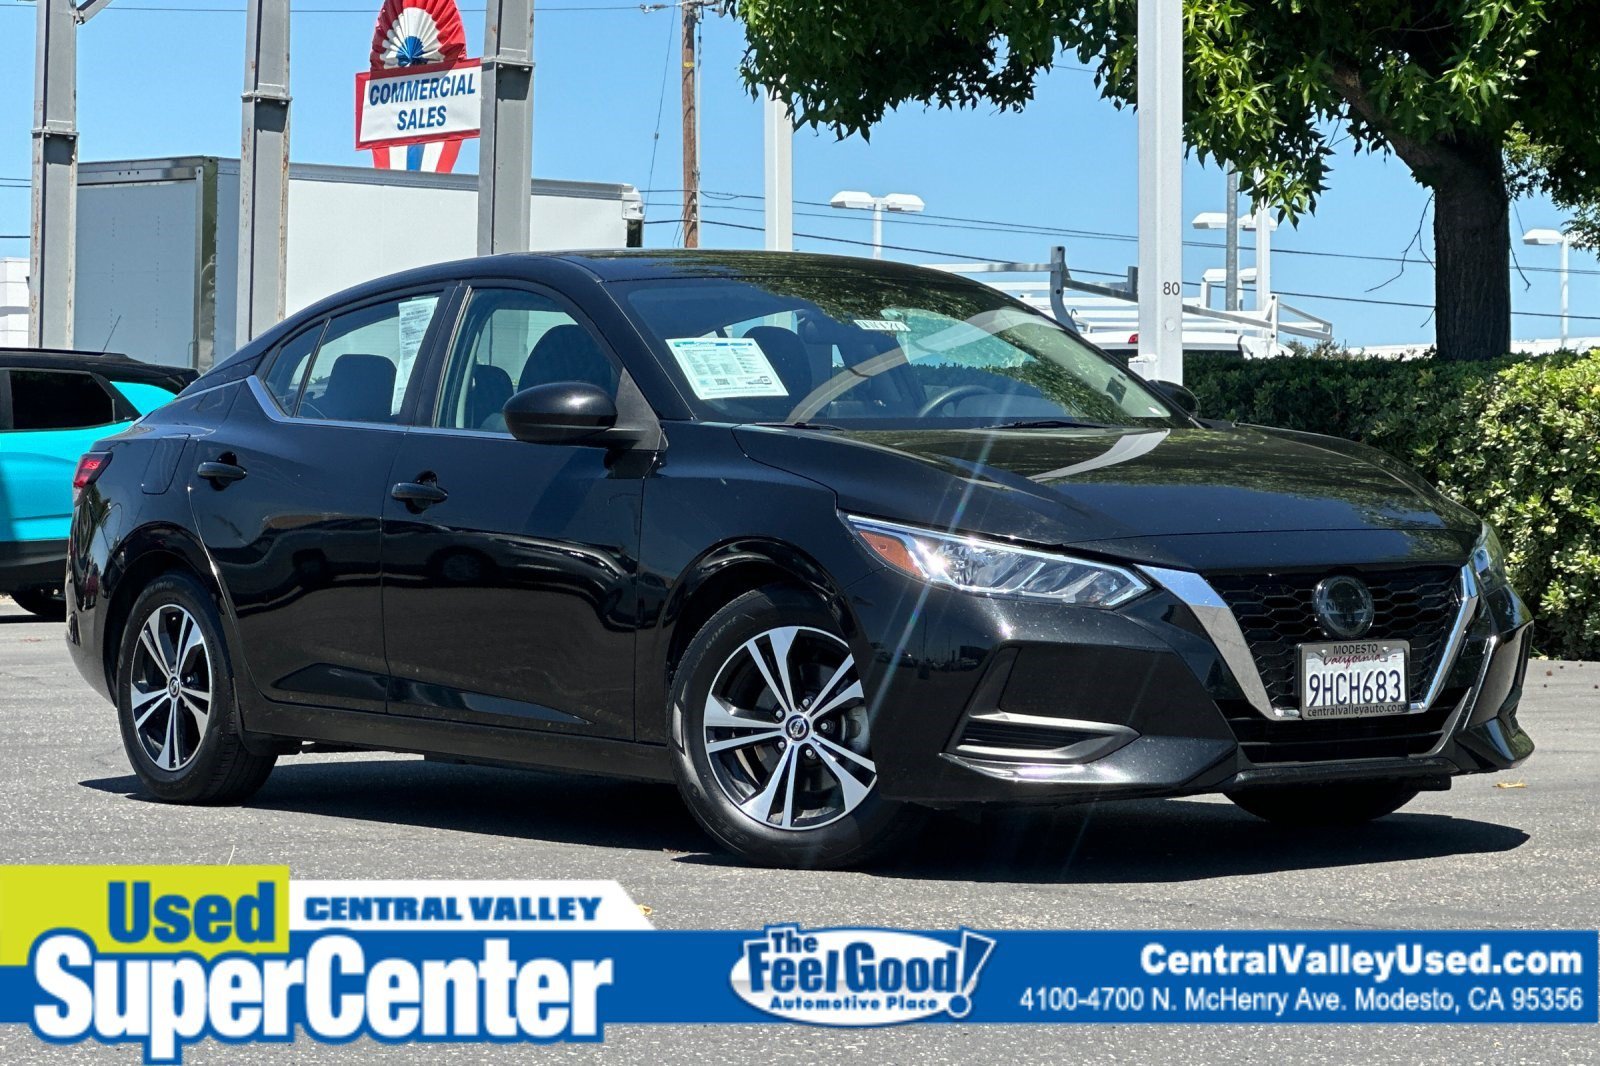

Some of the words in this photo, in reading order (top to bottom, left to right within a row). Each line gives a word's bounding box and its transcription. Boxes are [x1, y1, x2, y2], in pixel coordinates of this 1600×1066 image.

[369, 73, 476, 106] COMMERCIAL
[397, 105, 447, 131] SALES
[1163, 281, 1180, 296] 80
[1333, 644, 1378, 655] MODESTO
[1309, 669, 1401, 707] 9HCH683
[1307, 701, 1406, 717] centralvalleyauto.com
